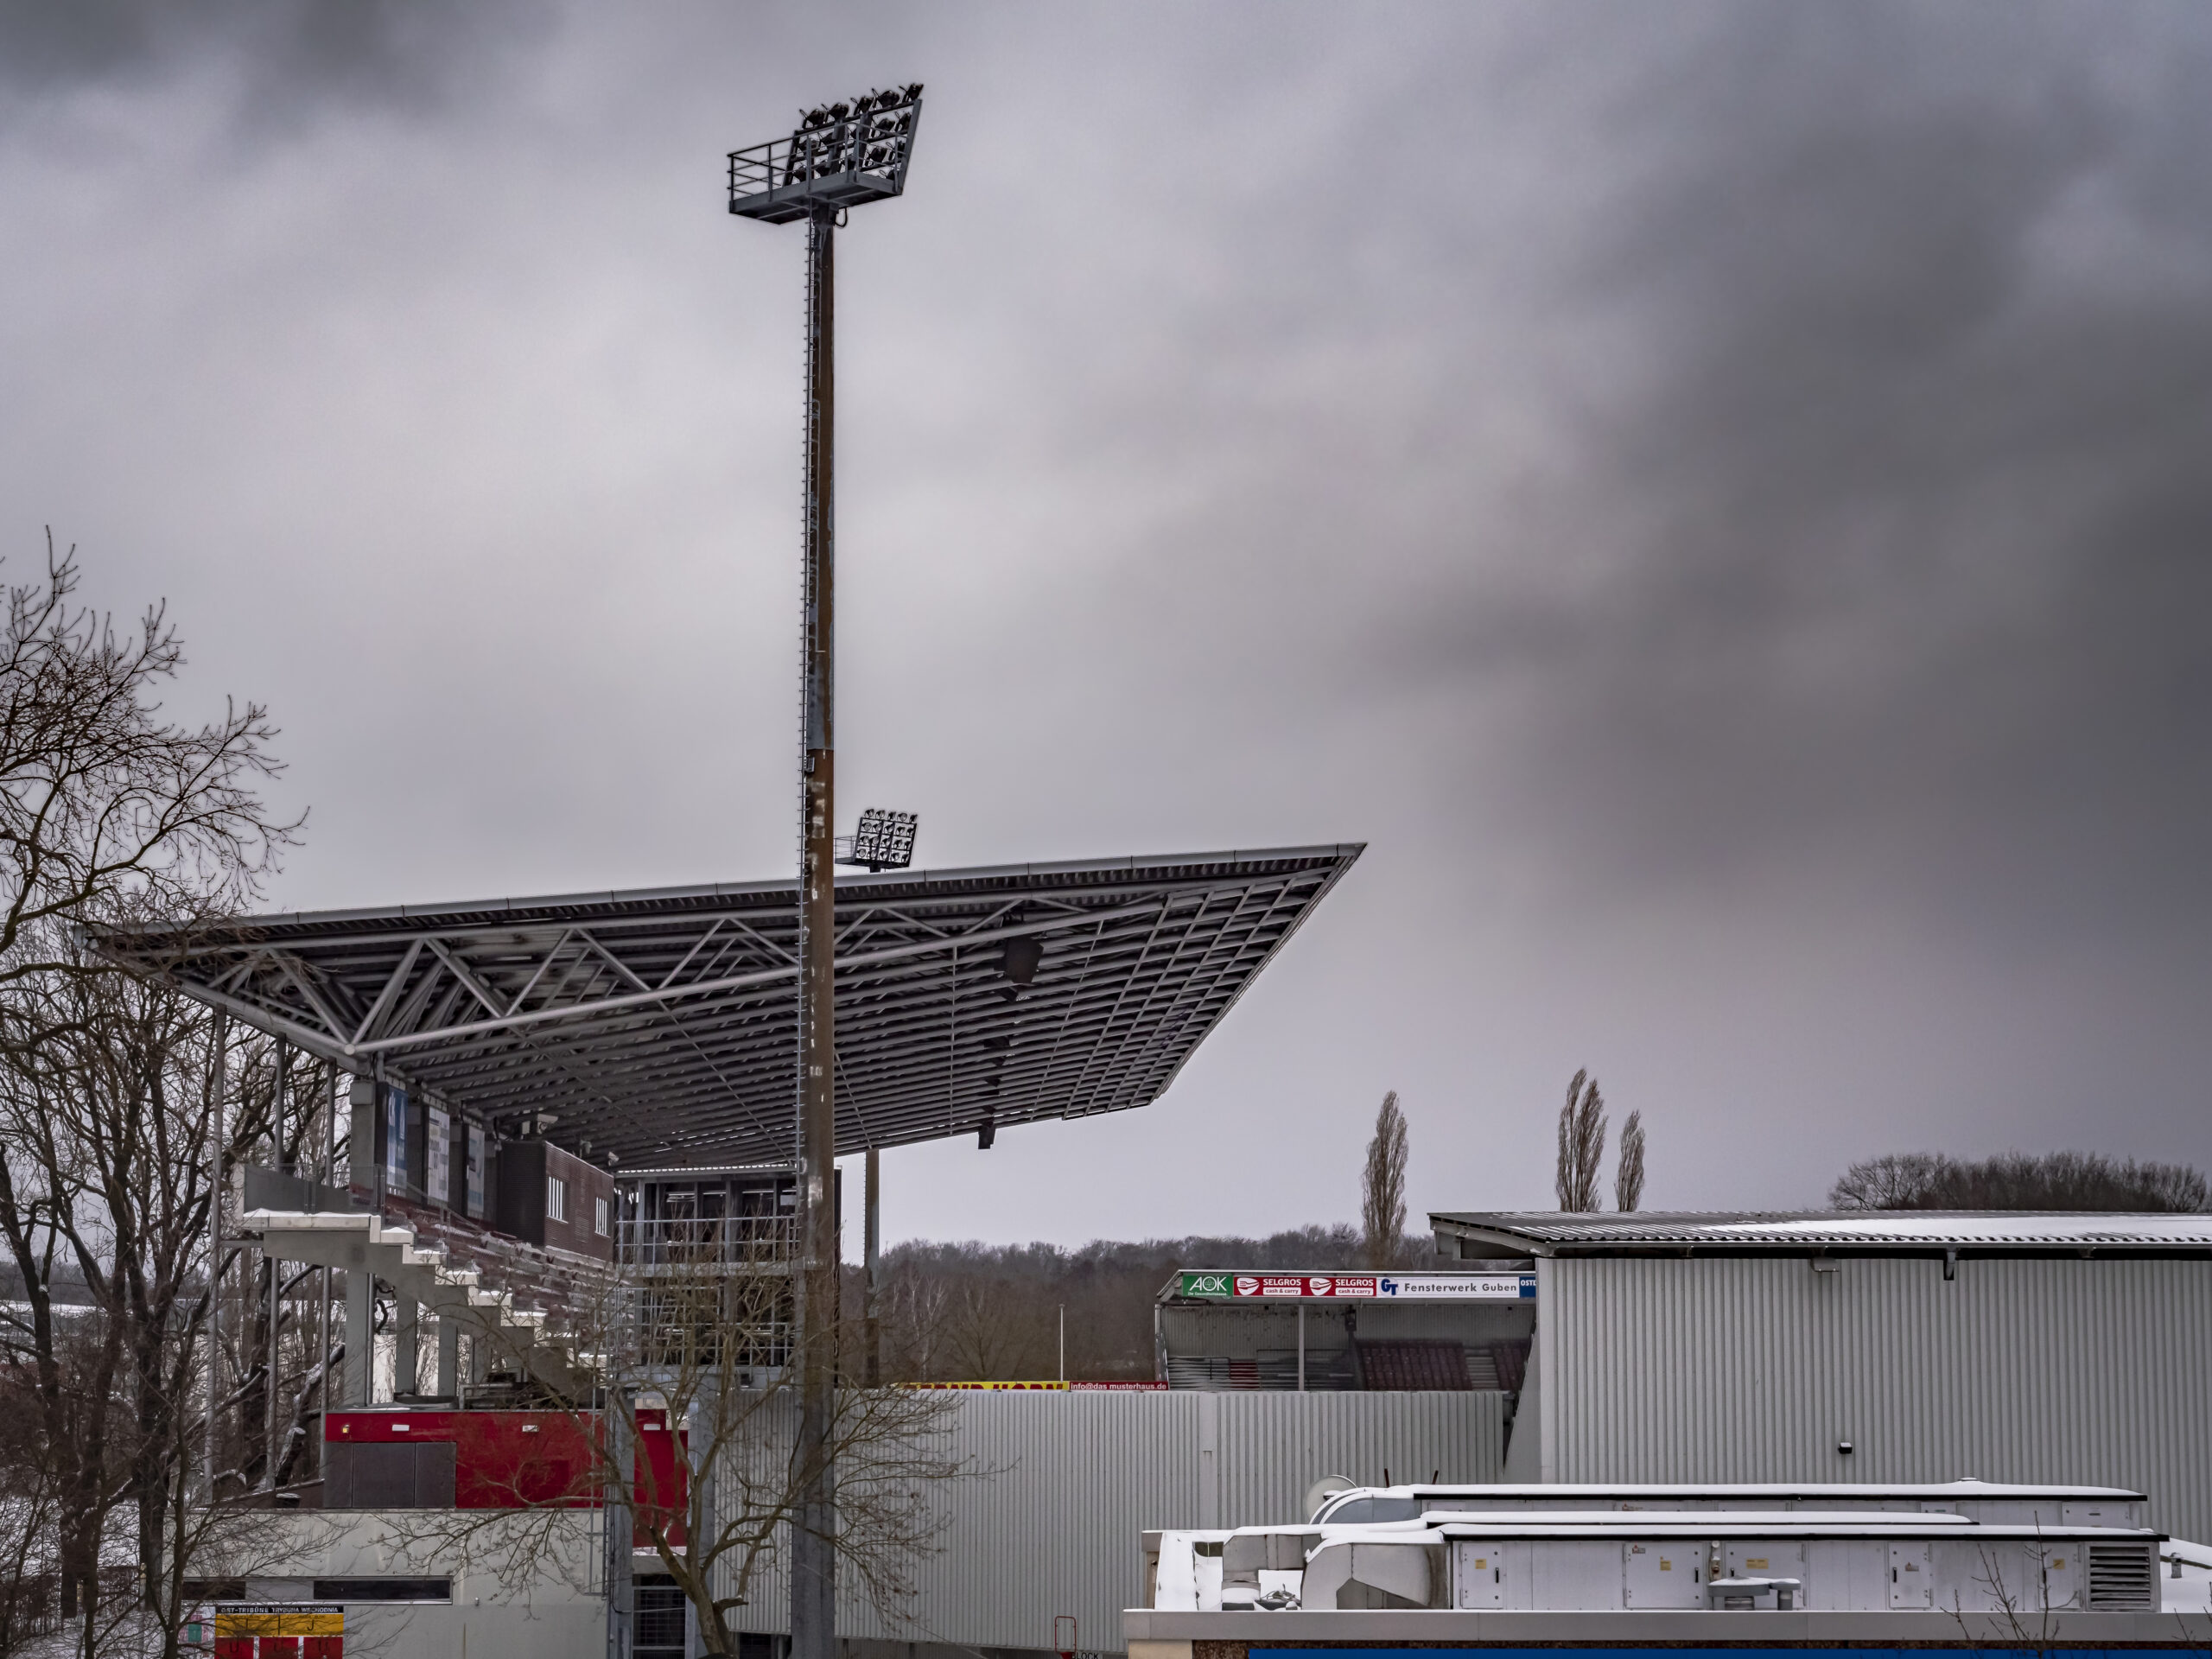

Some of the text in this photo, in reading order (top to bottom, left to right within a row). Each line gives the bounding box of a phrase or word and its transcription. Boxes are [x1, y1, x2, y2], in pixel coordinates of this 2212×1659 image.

[1189, 1276, 1227, 1292] AOK
[1404, 1283, 1516, 1292] Fensterwerk Guben
